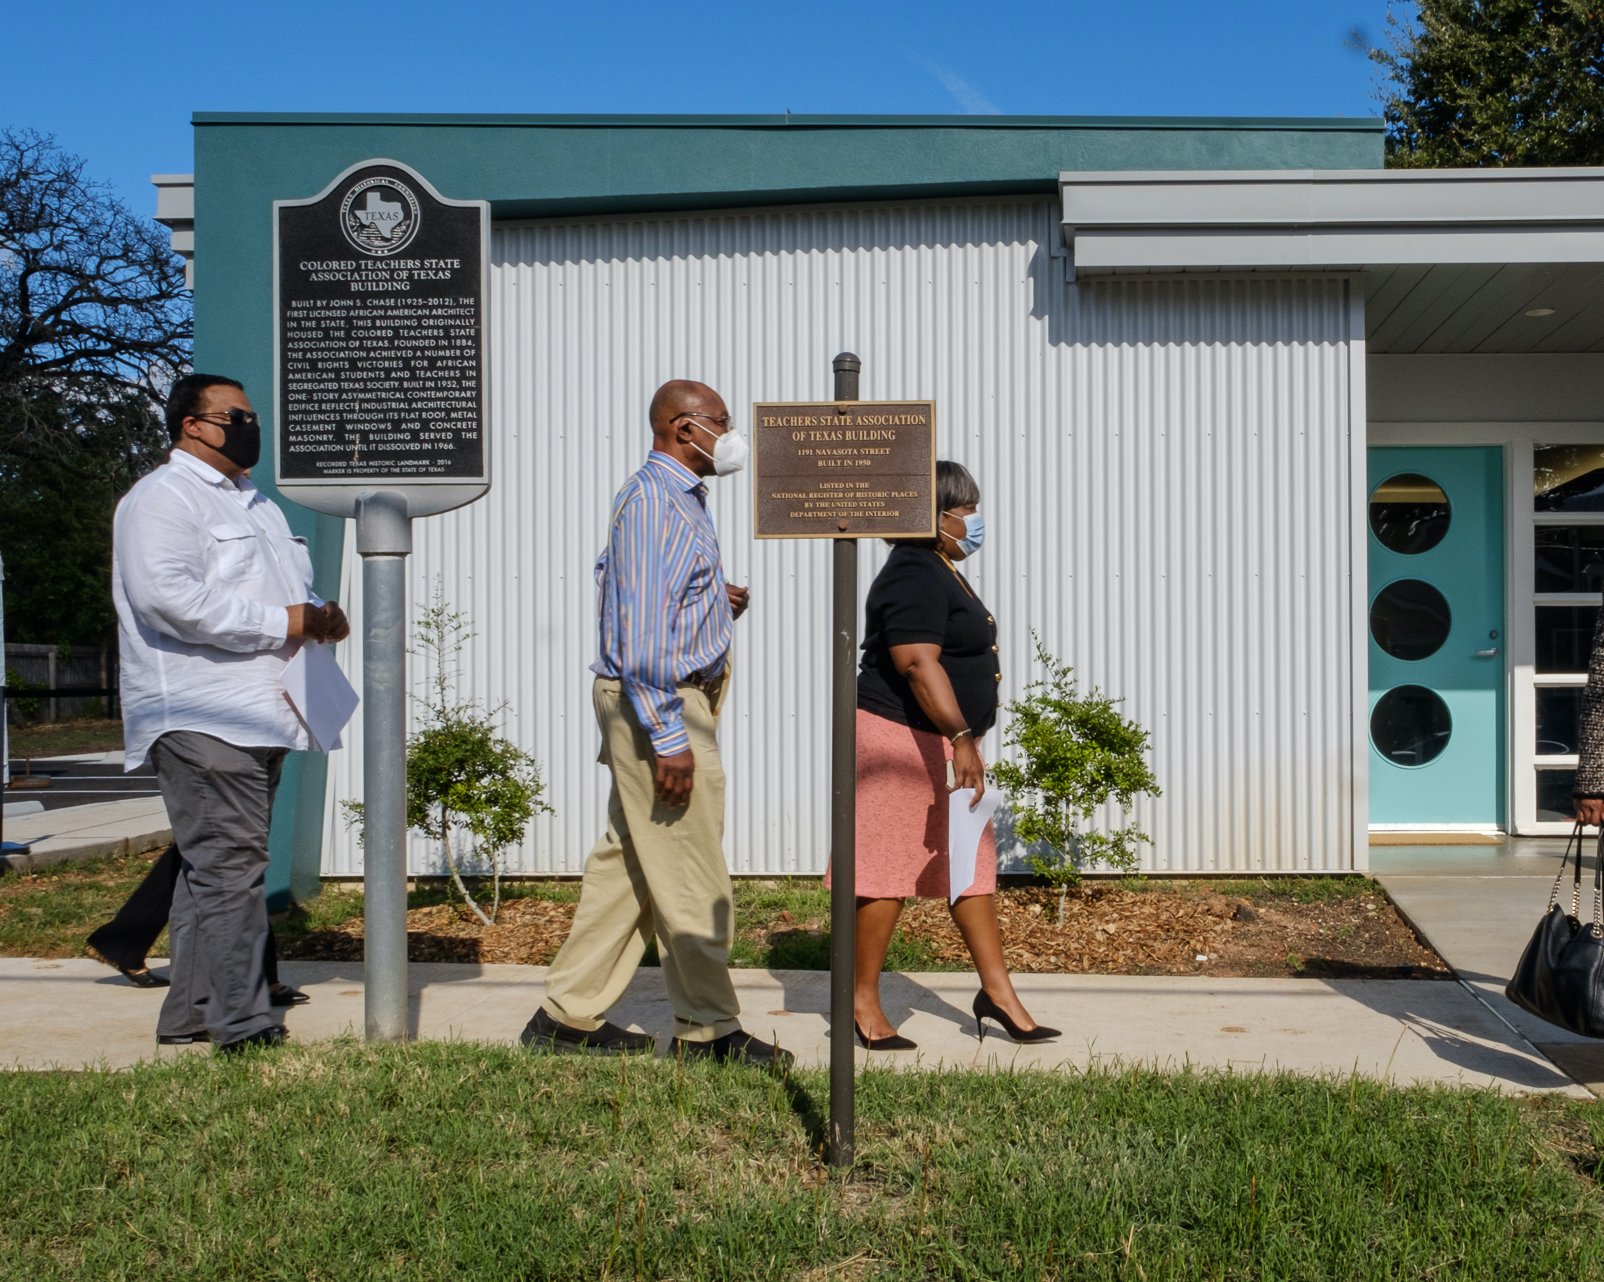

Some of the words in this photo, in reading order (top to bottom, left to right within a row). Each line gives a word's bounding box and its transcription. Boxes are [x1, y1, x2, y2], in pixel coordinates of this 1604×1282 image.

[364, 212, 399, 220] TEXAS
[300, 261, 356, 270] COLORED
[359, 260, 421, 269] TEACHERS
[424, 259, 460, 268] STATE
[310, 271, 390, 281] ASSOCIATION
[394, 271, 409, 280] OF
[412, 270, 451, 279] TEXAS
[351, 282, 410, 291] BUILDING
[437, 381, 459, 389] 1952,
[422, 412, 448, 420] ROOF,
[763, 416, 817, 427] TEACHERS
[820, 416, 853, 426] STATE
[856, 414, 926, 426] ASSOCIATION
[792, 431, 806, 441] OF
[809, 431, 843, 441] TEXAS
[846, 430, 896, 441] BUILDING
